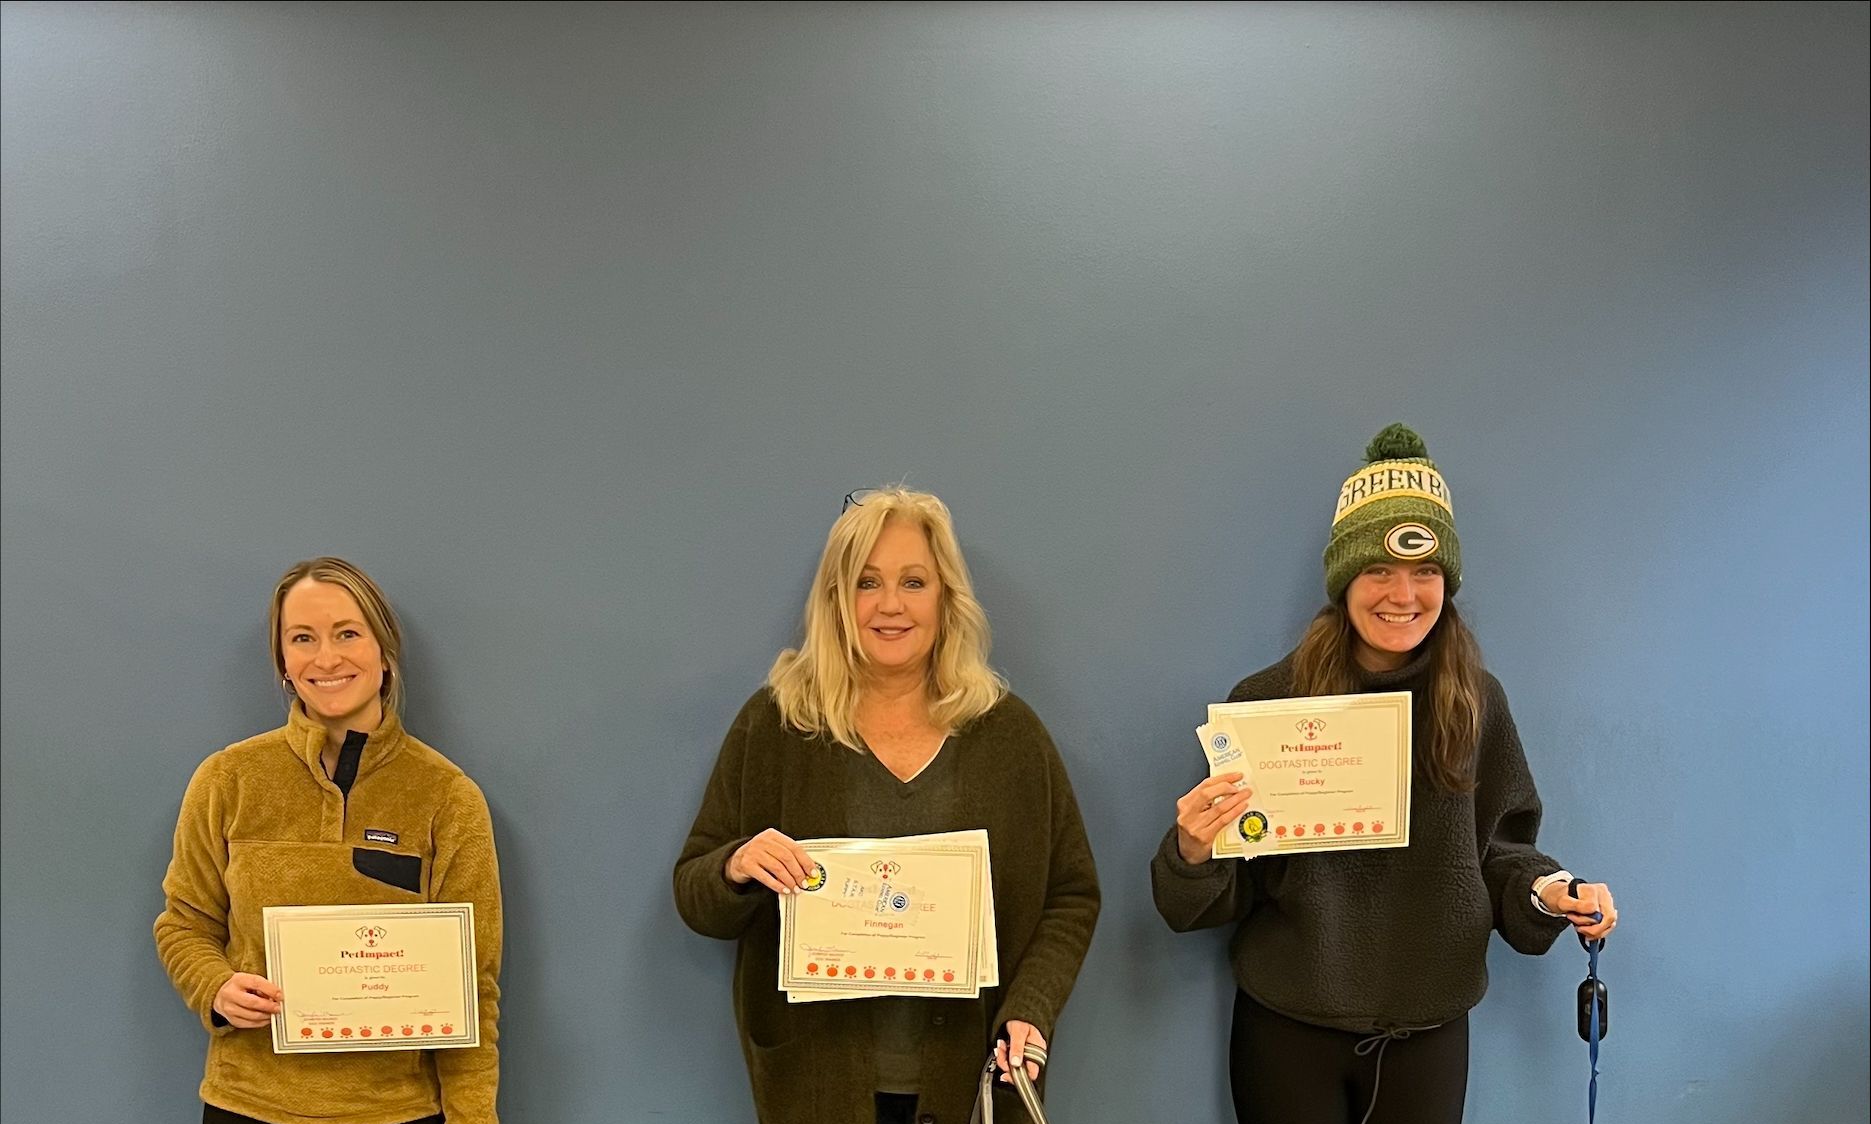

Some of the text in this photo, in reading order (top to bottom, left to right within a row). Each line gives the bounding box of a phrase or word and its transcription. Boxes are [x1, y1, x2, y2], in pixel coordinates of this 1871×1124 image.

[1339, 468, 1423, 511] GREEN
[1387, 525, 1436, 558] G
[1281, 742, 1342, 753] PetImpact!
[1259, 756, 1363, 770] DOGTASTIC DEGREE
[1299, 778, 1325, 786] Bucky
[864, 919, 904, 929] Finnegan
[340, 949, 404, 960] PetImpact!
[319, 963, 427, 975] DOGTASTIC DEGREE
[361, 983, 389, 992] Puddy
